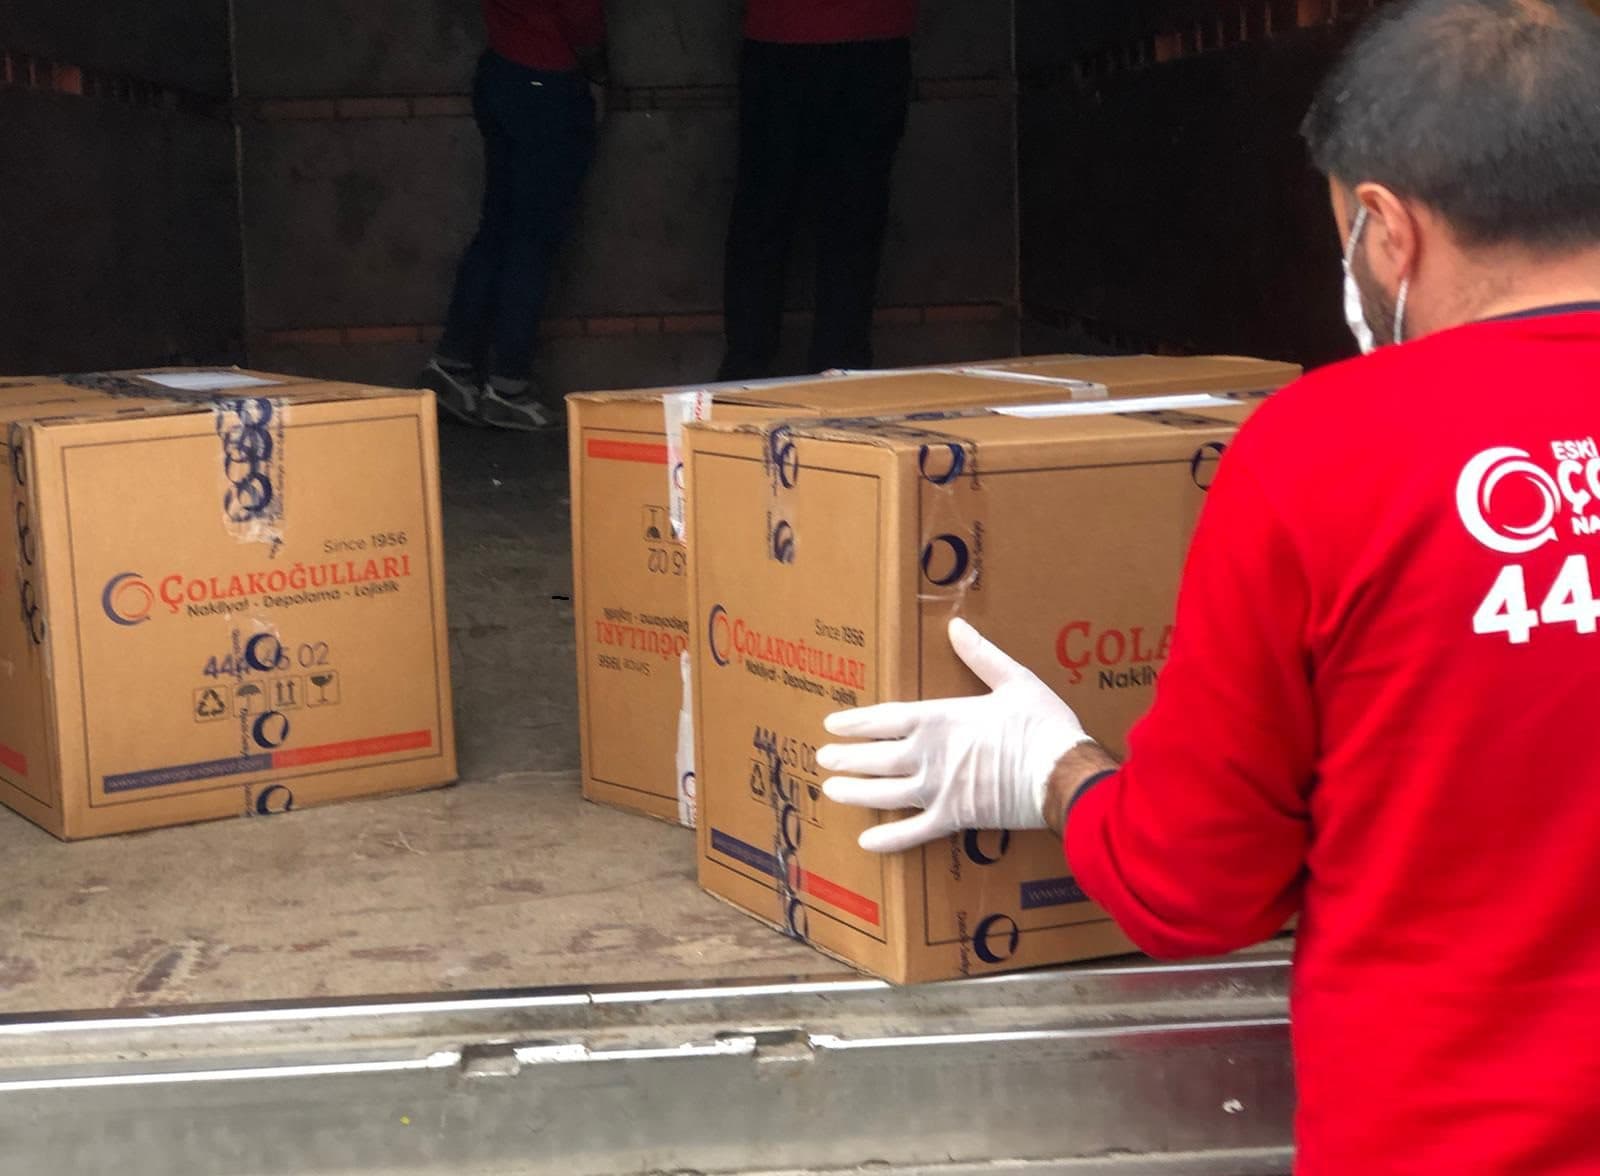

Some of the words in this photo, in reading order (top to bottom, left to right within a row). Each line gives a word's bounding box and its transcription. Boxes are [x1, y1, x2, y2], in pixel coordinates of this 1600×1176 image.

[324, 538, 367, 553] Since
[371, 531, 408, 548] 1956
[160, 554, 411, 614] ÇOLAKOĞULLARI
[187, 597, 249, 617] Nakliyat
[263, 589, 340, 609] Depolama
[354, 581, 400, 599] Lojistik
[815, 618, 841, 641] Since
[298, 640, 329, 668] 02
[733, 618, 865, 691] ÇOLAKOĞULLARI
